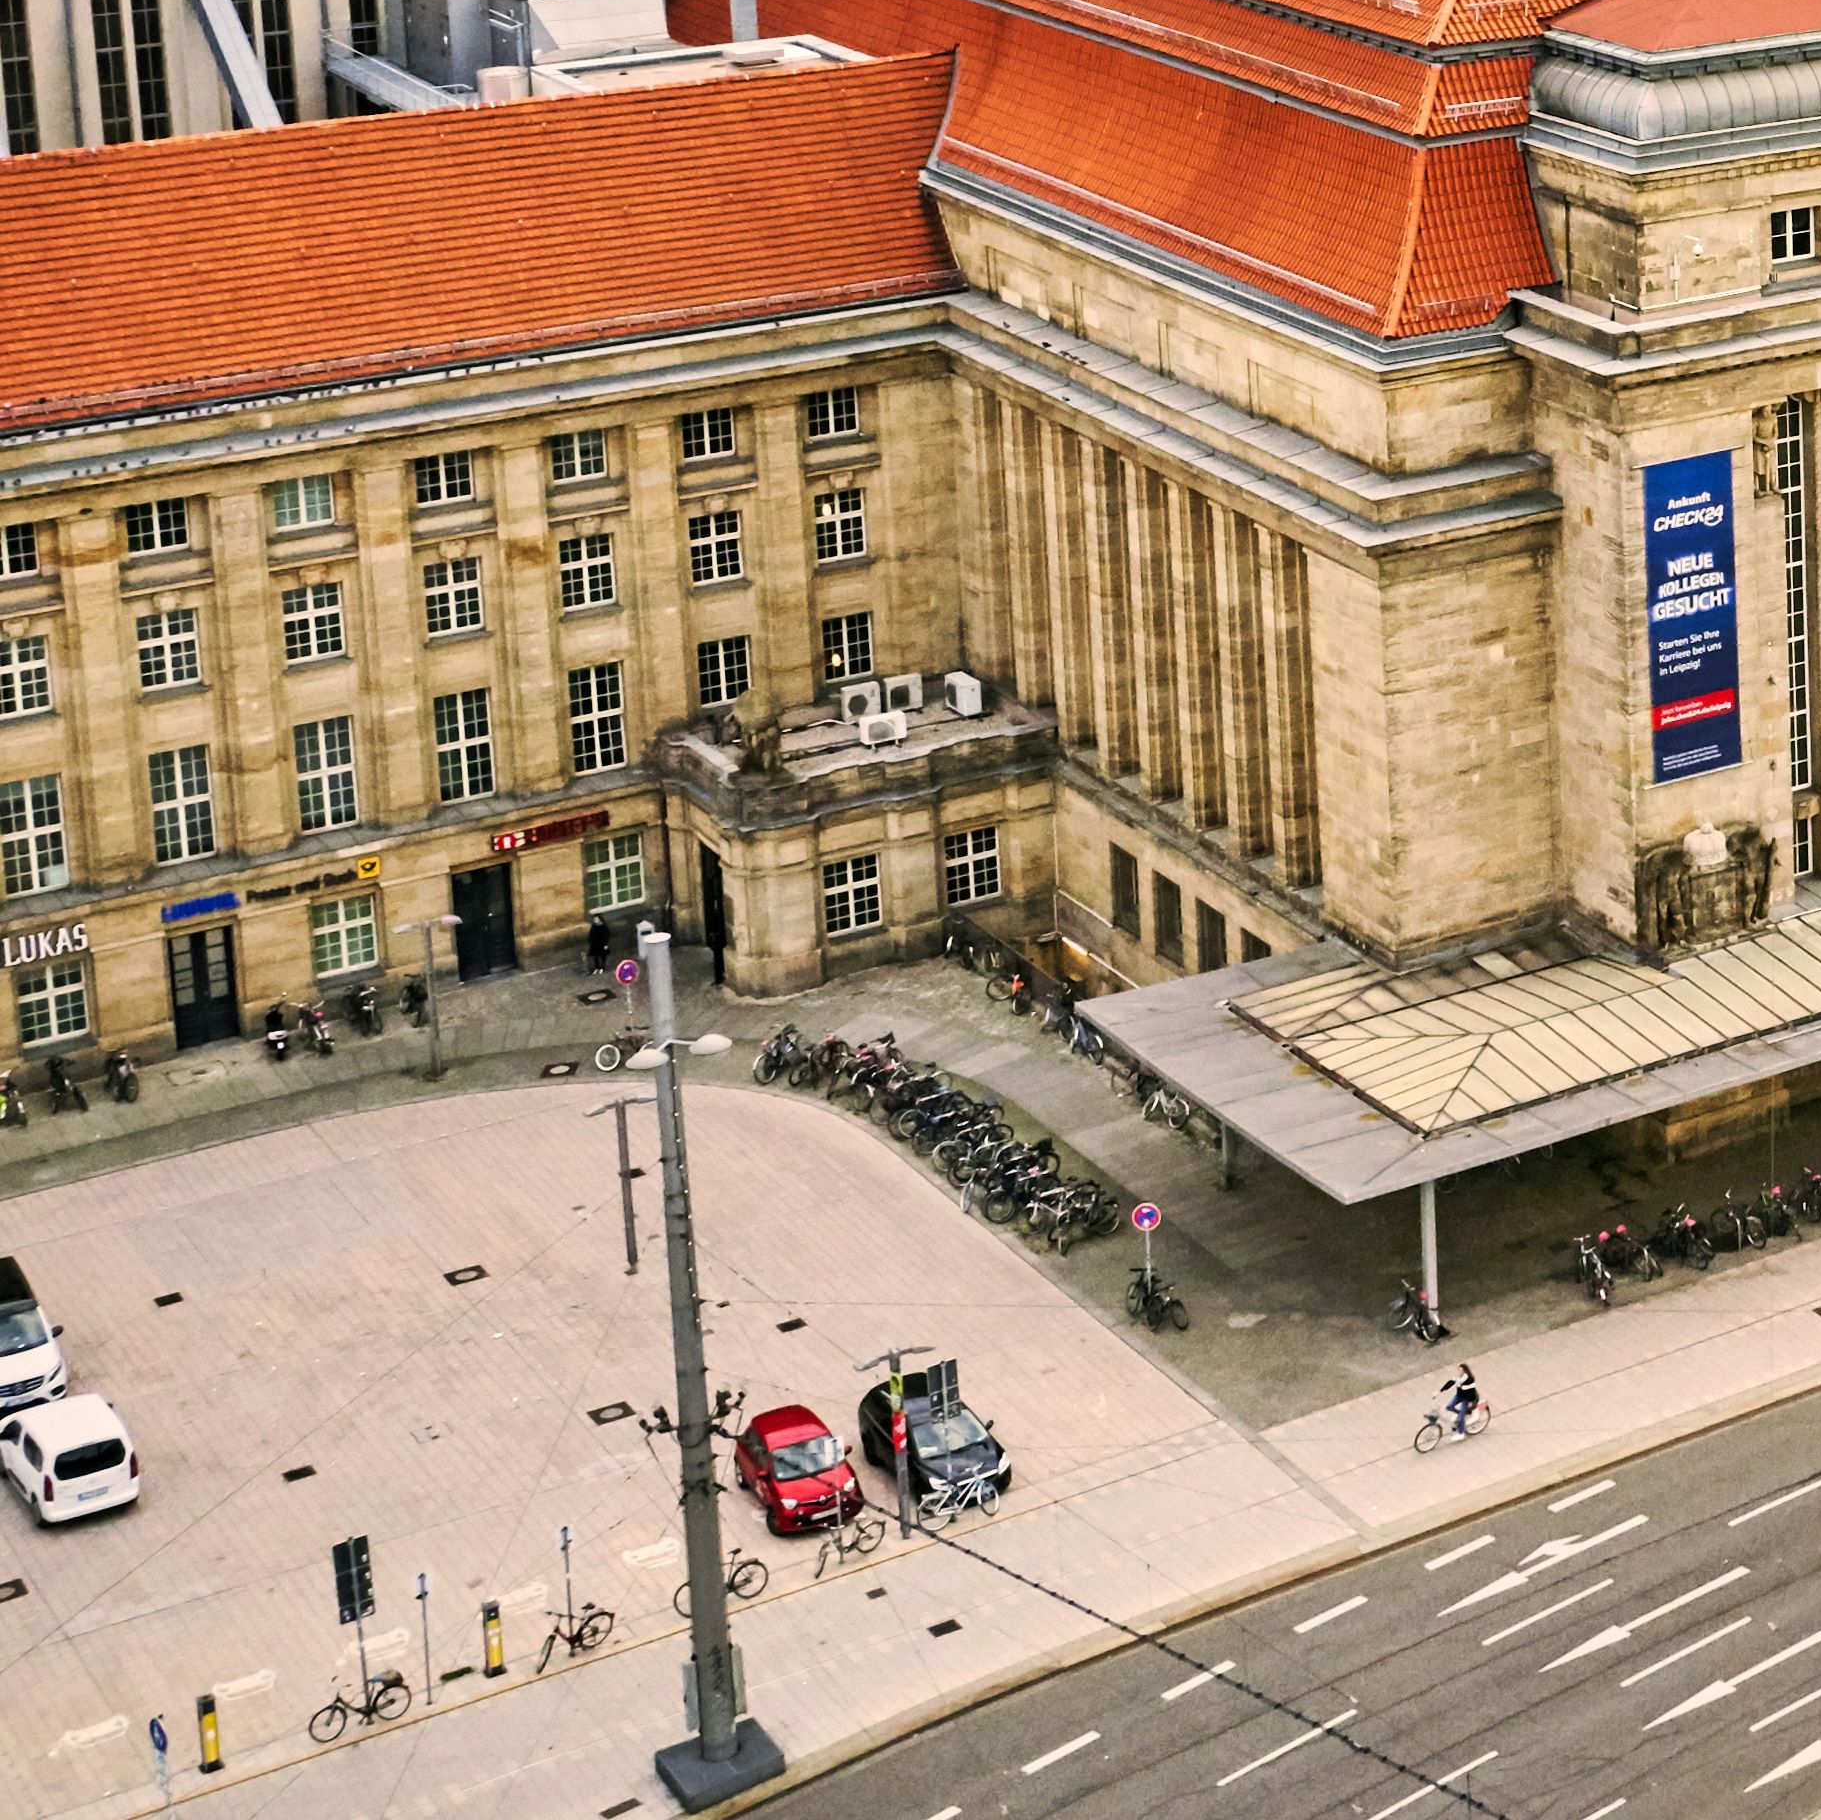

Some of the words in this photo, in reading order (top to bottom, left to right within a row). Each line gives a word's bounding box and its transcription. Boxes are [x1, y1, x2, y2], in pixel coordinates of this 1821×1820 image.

[1667, 491, 1712, 510] Ankunft
[1653, 505, 1724, 532] CHECK24
[1667, 552, 1714, 577] NEUE
[1658, 572, 1725, 599] KOLLEGEN
[1652, 587, 1731, 621] GESUCHT
[1658, 637, 1689, 651] Starten
[1690, 634, 1703, 643] Sie
[1703, 630, 1720, 639] Ihre
[1659, 650, 1691, 663] Karriere
[1692, 644, 1706, 655] bei
[1707, 641, 1722, 652] uns
[1659, 667, 1668, 676] in
[1669, 658, 1701, 674] Leipzig!
[2, 923, 89, 967] LUKAS
